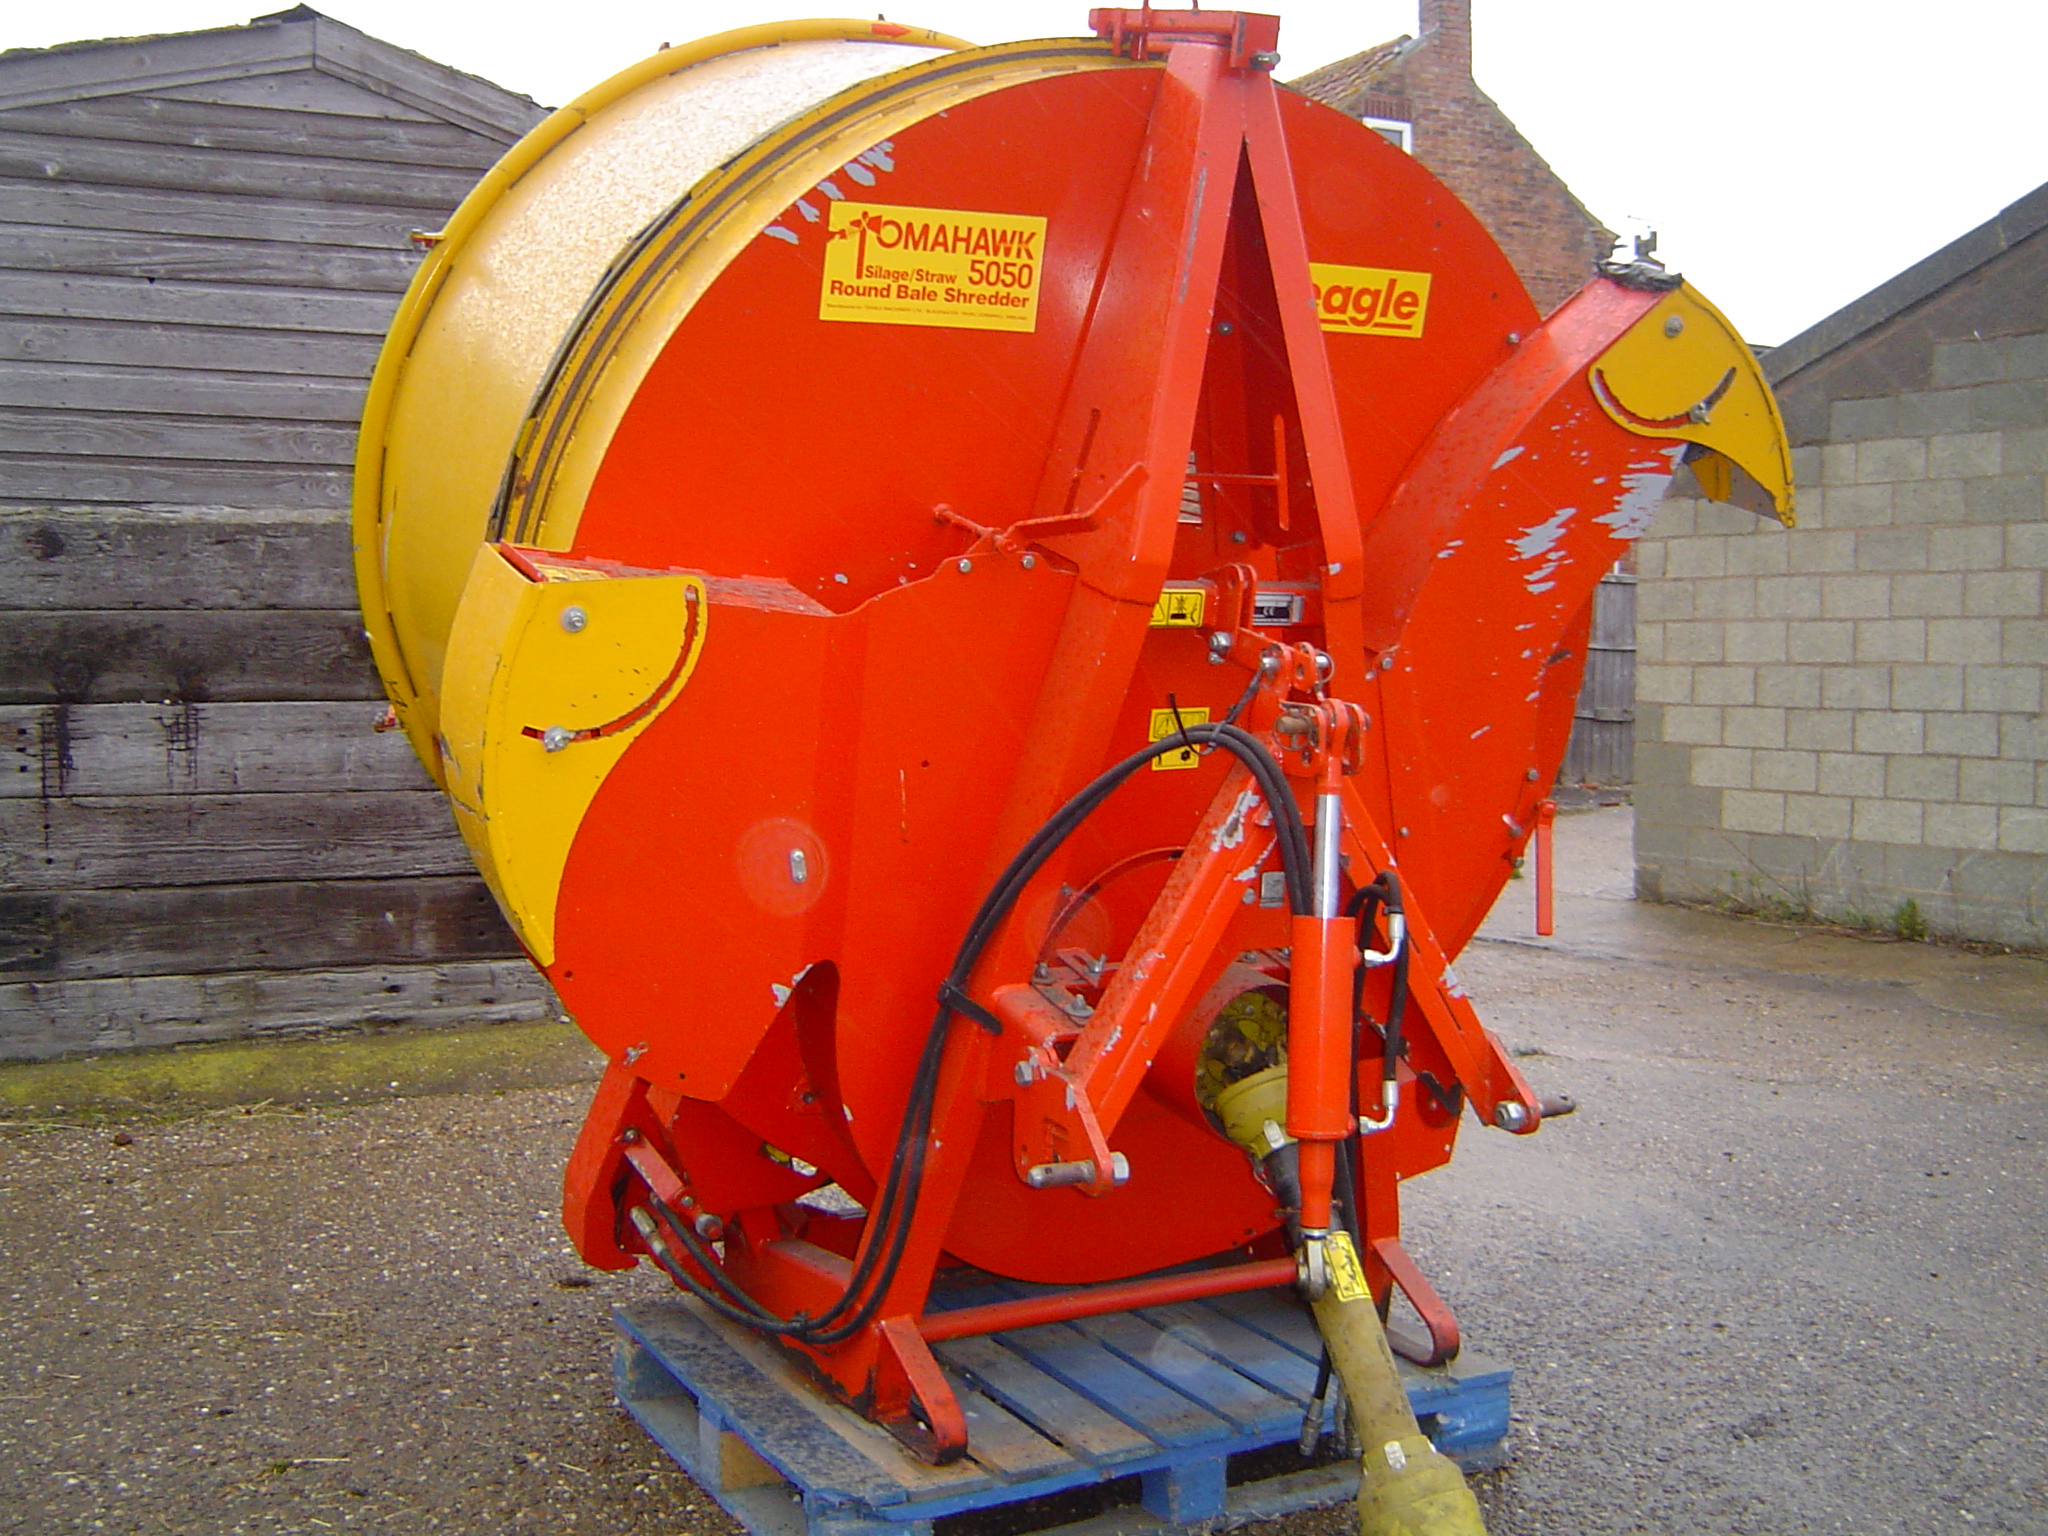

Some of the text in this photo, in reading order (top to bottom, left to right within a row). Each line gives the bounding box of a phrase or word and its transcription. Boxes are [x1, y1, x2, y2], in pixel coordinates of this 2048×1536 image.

[864, 265, 957, 285] Silage/Straw
[968, 260, 1033, 289] 5050
[830, 280, 1029, 308] Round Bale Shredder
